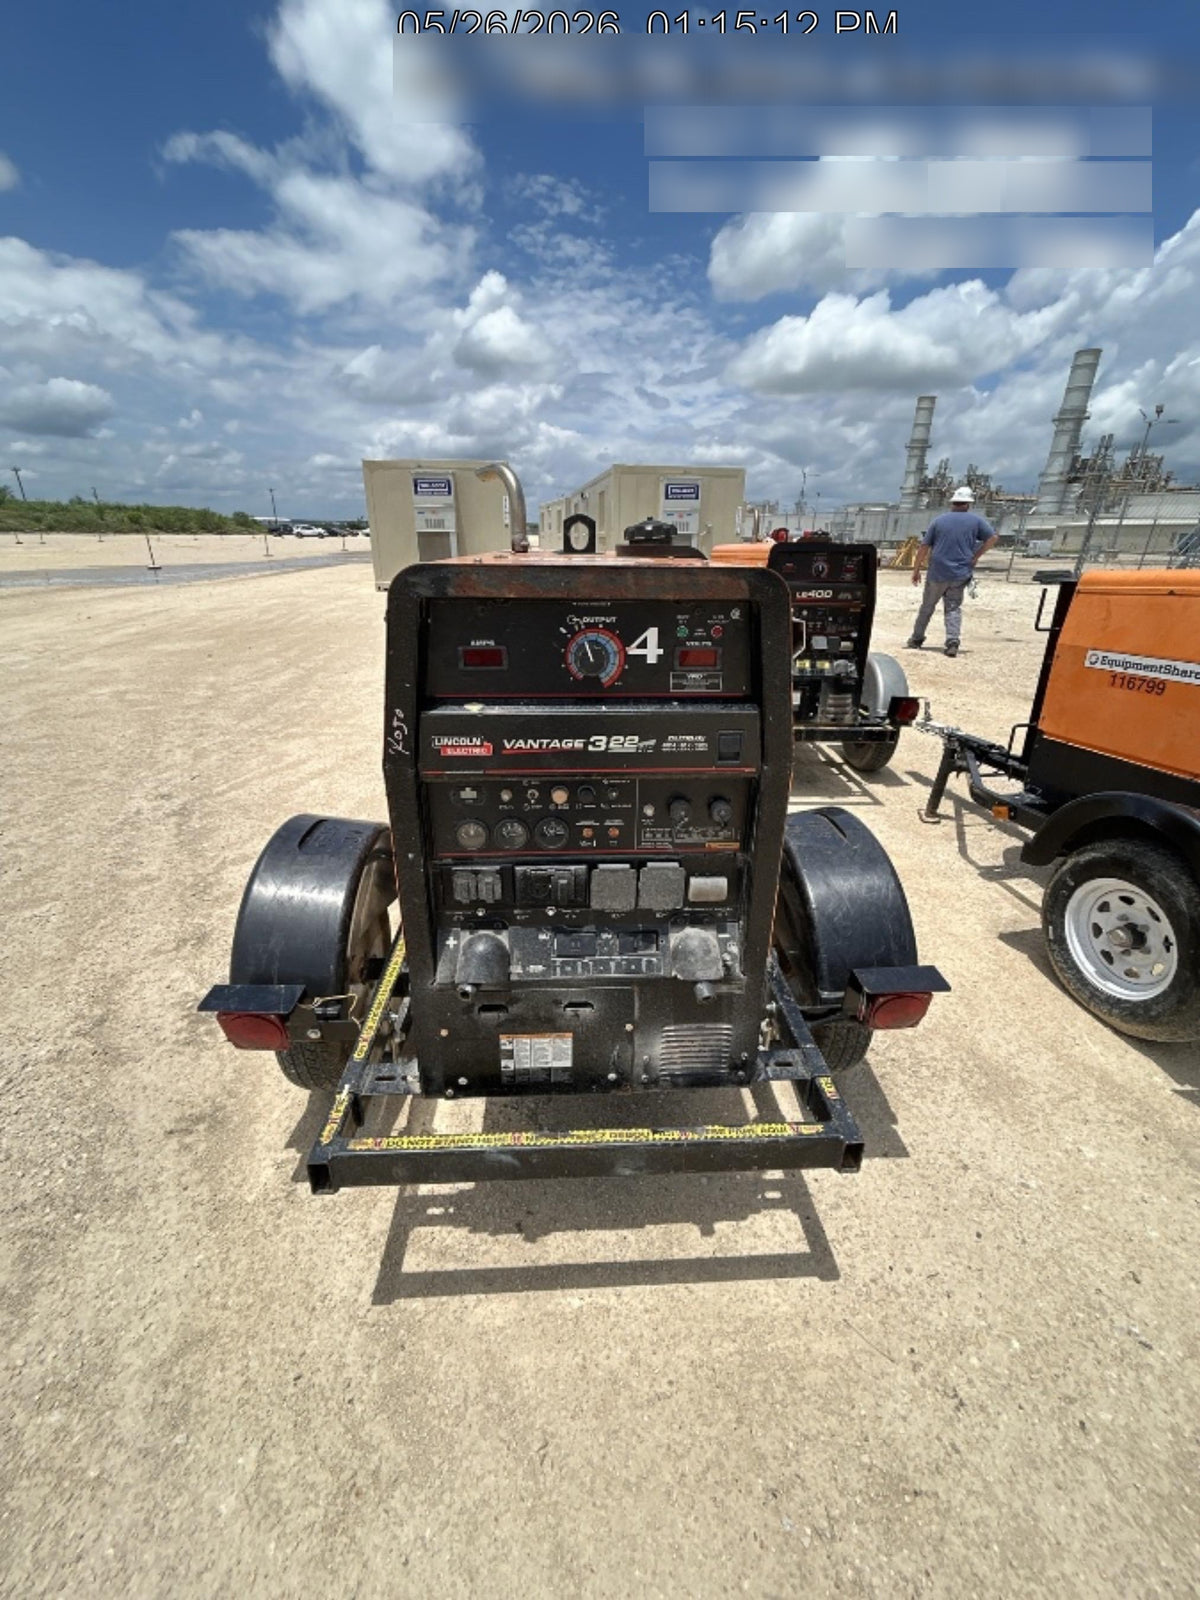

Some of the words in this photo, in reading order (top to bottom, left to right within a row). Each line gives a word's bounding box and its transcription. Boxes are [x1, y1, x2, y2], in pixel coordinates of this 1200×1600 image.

[582, 616, 617, 624] OUTPUT
[626, 627, 664, 664] 4
[1110, 672, 1167, 696] 116799
[434, 736, 482, 746] LINCOLN
[503, 739, 585, 749] VANTAGE
[588, 735, 640, 751] 322
[386, 1140, 404, 1148] DO
[407, 1138, 432, 1146] NOT
